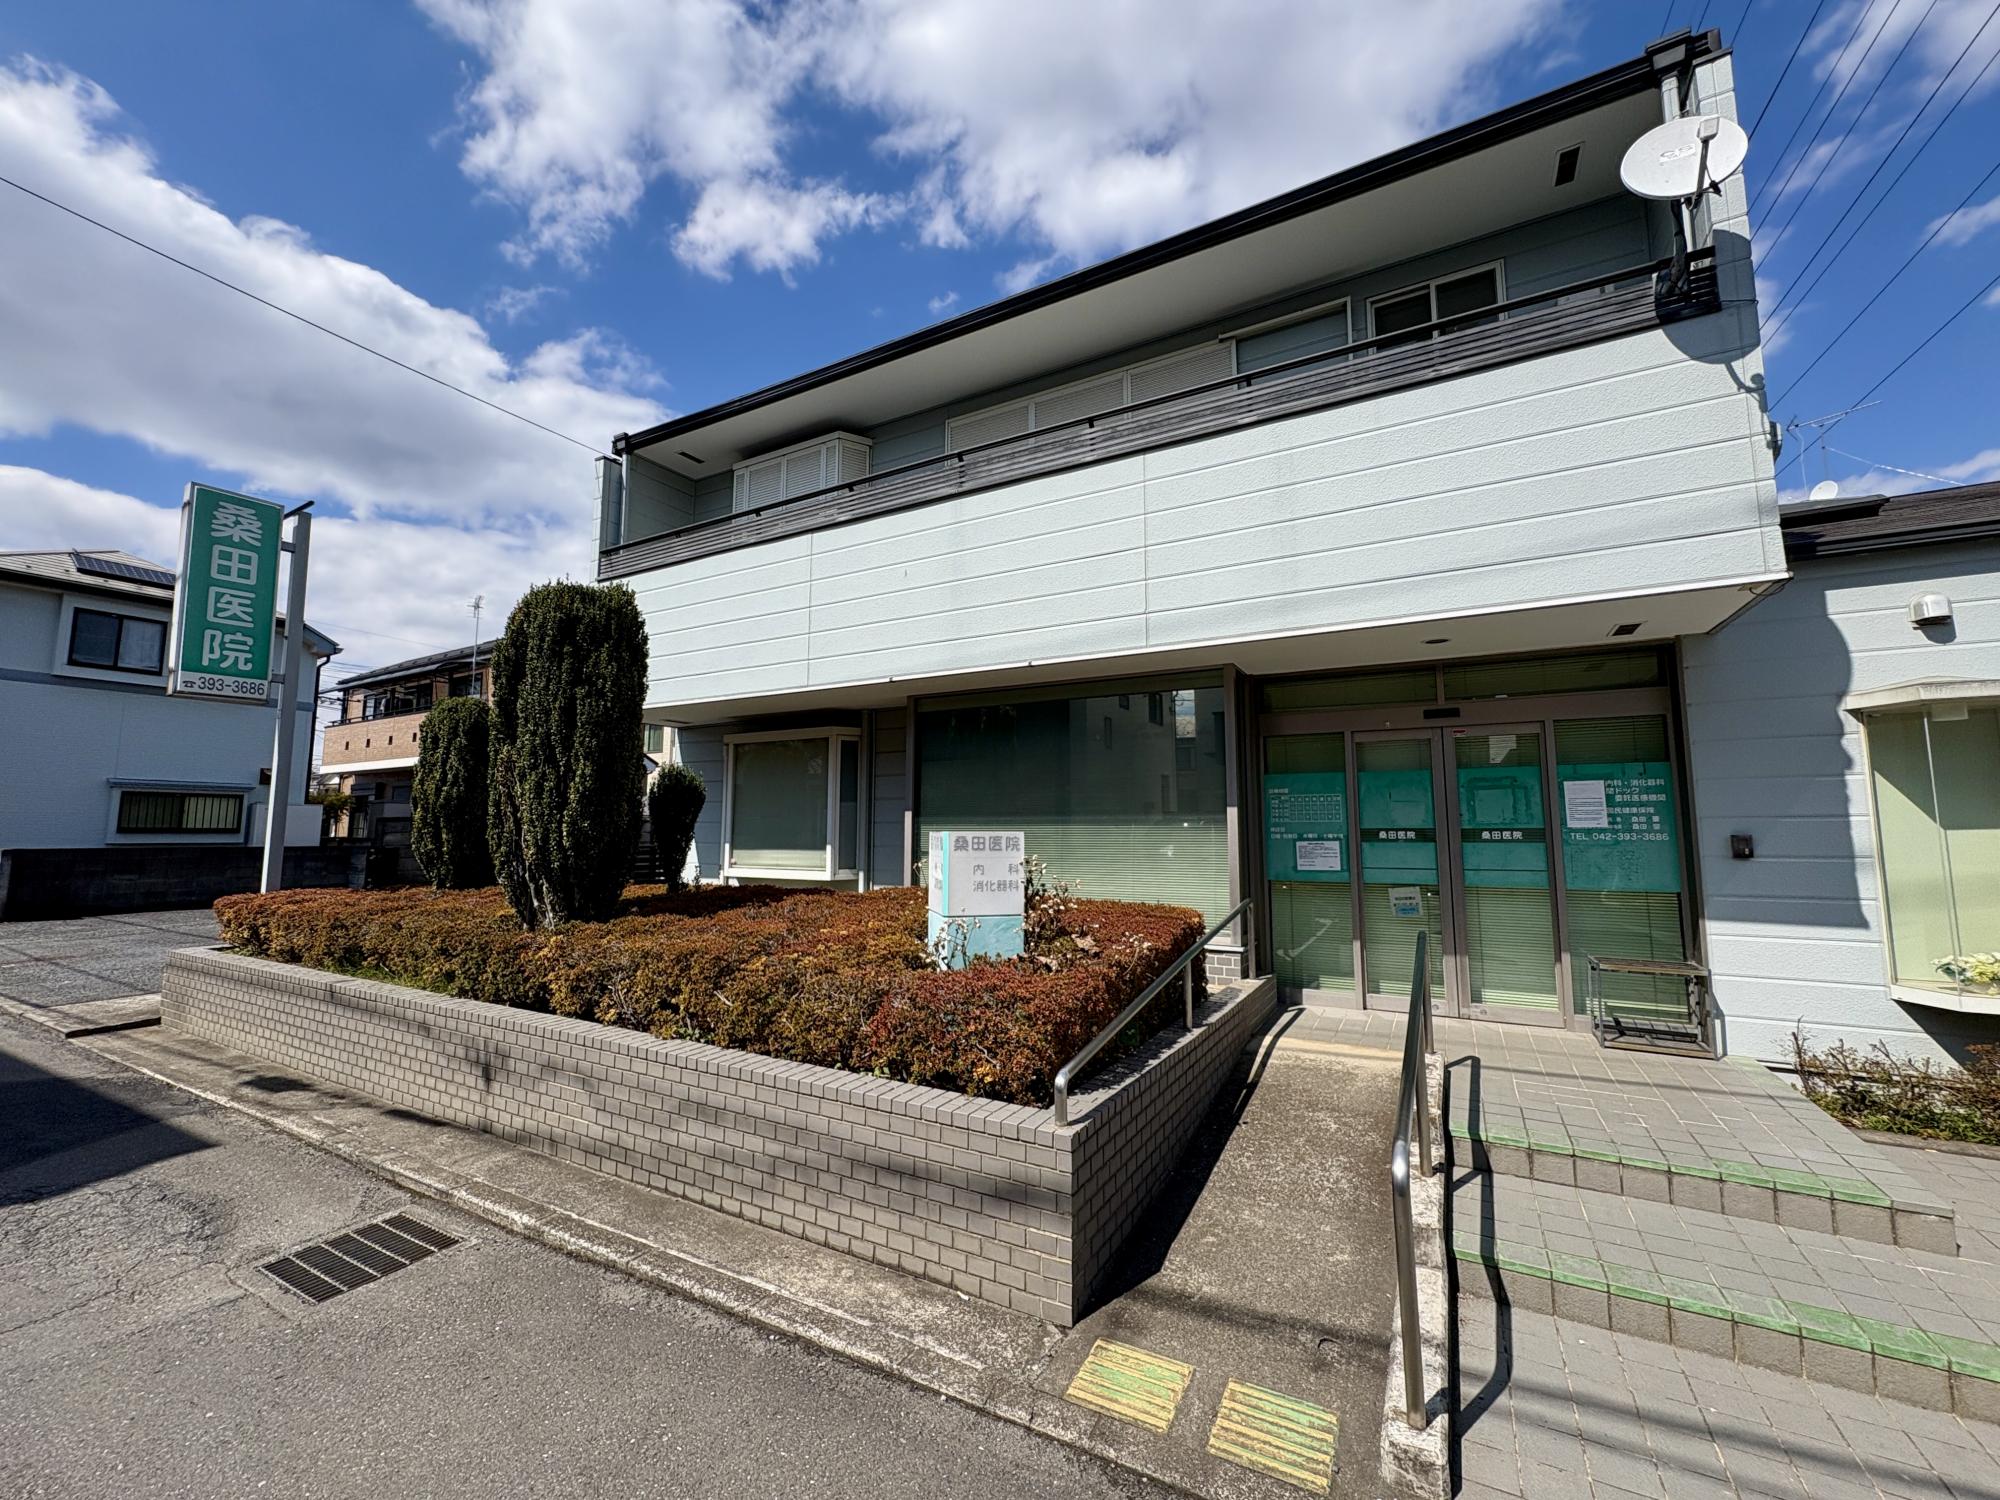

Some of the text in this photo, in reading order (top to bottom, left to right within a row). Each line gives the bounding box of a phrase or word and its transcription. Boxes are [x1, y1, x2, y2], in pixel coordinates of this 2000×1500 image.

[202, 501, 263, 671] 桑田医院
[198, 677, 265, 696] 393-3686
[1379, 830, 1416, 840] 桑田医院
[1481, 830, 1523, 840] 桑田医院
[1570, 832, 1670, 841] TEL 042-393-3686
[953, 835, 1021, 852] 桑田医院
[973, 880, 1019, 892] 消化器科
